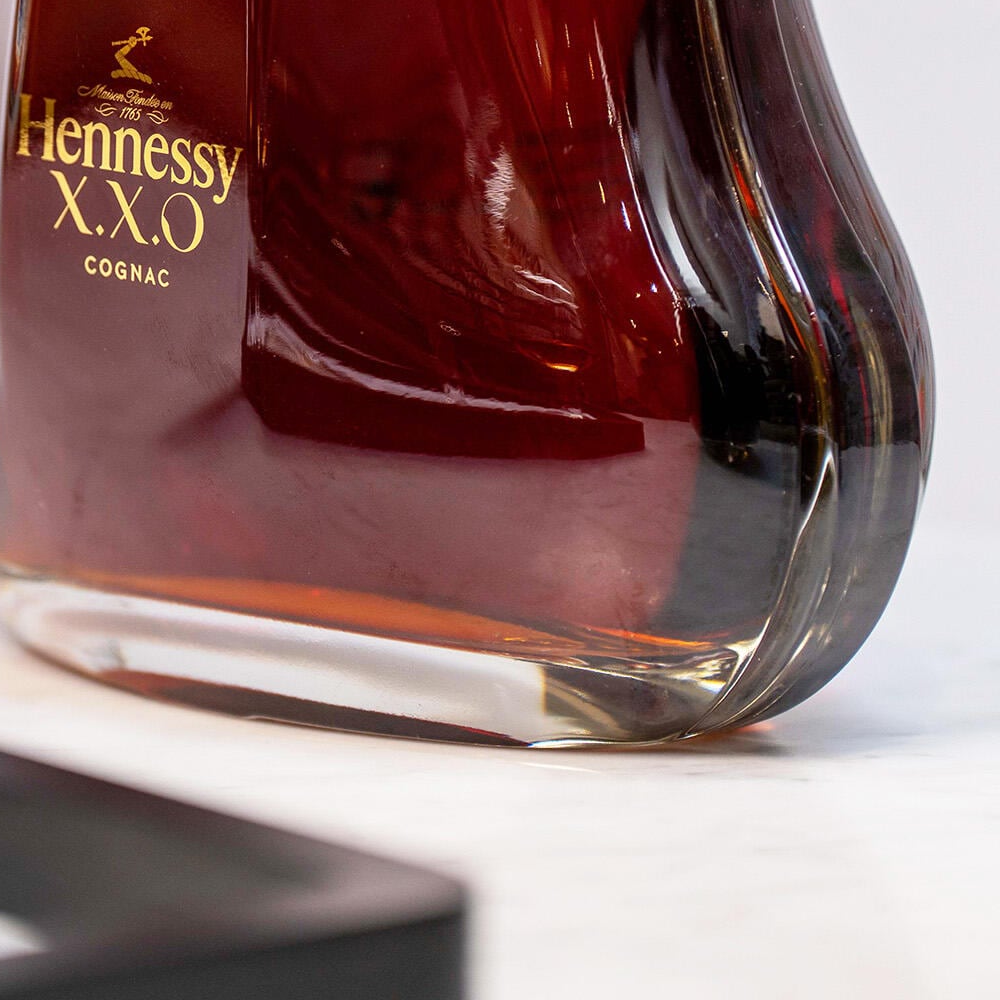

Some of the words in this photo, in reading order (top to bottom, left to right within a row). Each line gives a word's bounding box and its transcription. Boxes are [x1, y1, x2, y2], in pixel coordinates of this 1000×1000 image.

[77, 84, 125, 103] Maison
[160, 100, 173, 110] en
[119, 106, 142, 121] 1765
[16, 93, 244, 204] Hennessy
[50, 170, 204, 253] X.X.O
[84, 255, 170, 288] COGNAC
